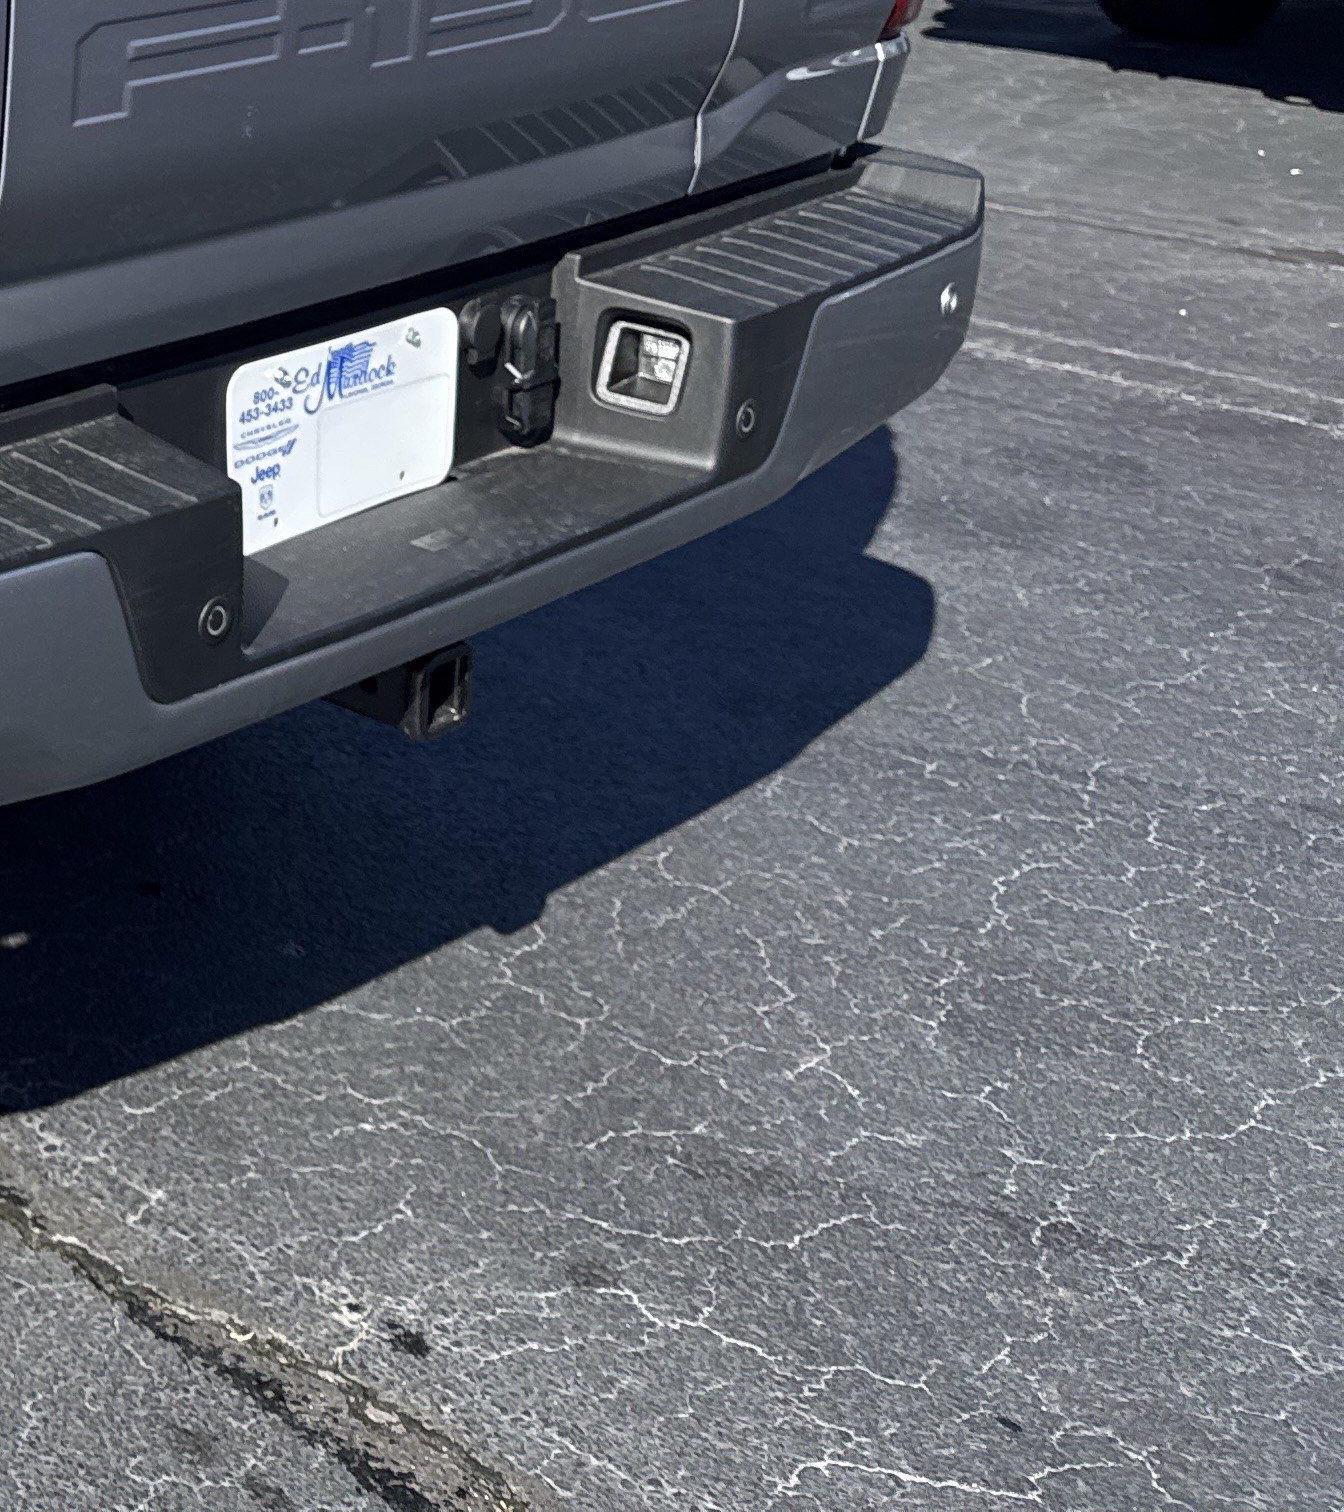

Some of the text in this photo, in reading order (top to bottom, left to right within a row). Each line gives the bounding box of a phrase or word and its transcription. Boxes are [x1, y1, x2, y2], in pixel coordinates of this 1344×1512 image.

[292, 362, 322, 394] Ed
[253, 387, 279, 405] 800-
[239, 396, 293, 424] 453-3433
[251, 463, 281, 484] Jeep
